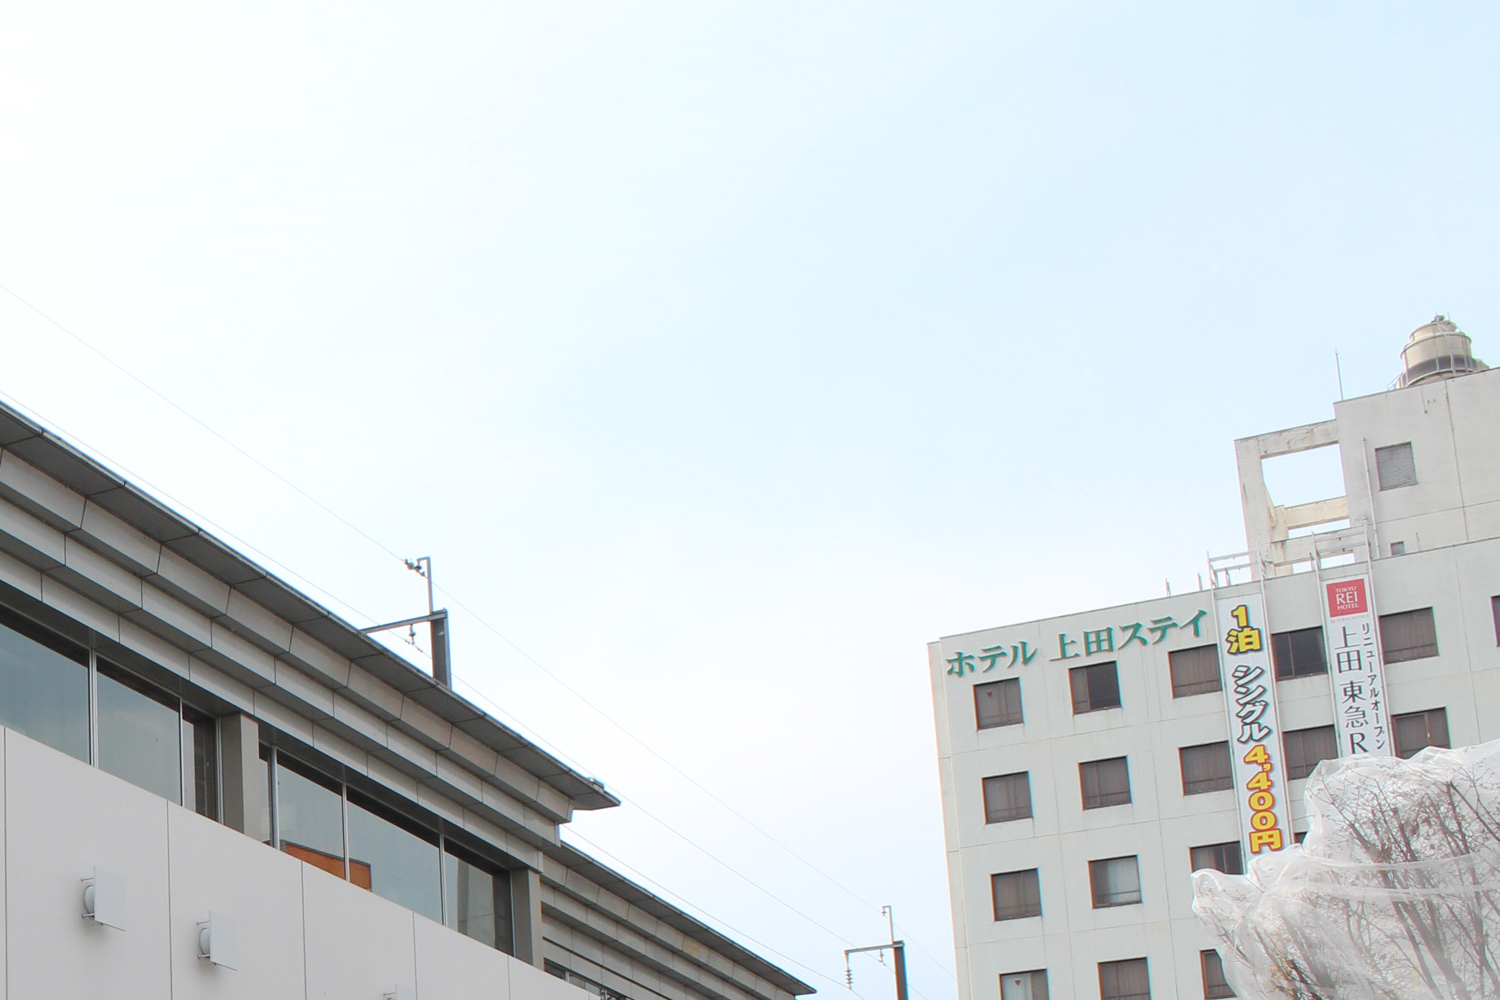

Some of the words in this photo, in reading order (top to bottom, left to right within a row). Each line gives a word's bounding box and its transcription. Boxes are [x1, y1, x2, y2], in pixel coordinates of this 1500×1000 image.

[1335, 586, 1357, 595] TOKYU
[1336, 592, 1359, 605] REI
[1337, 603, 1360, 611] HOTEL
[945, 640, 1038, 678] ホテル
[1049, 608, 1208, 664] 上田ステイ
[1226, 604, 1264, 655] 1泊
[1231, 664, 1272, 744] シングル
[1361, 622, 1387, 752] リニューアルオープン
[1243, 744, 1284, 855] 4,400円
